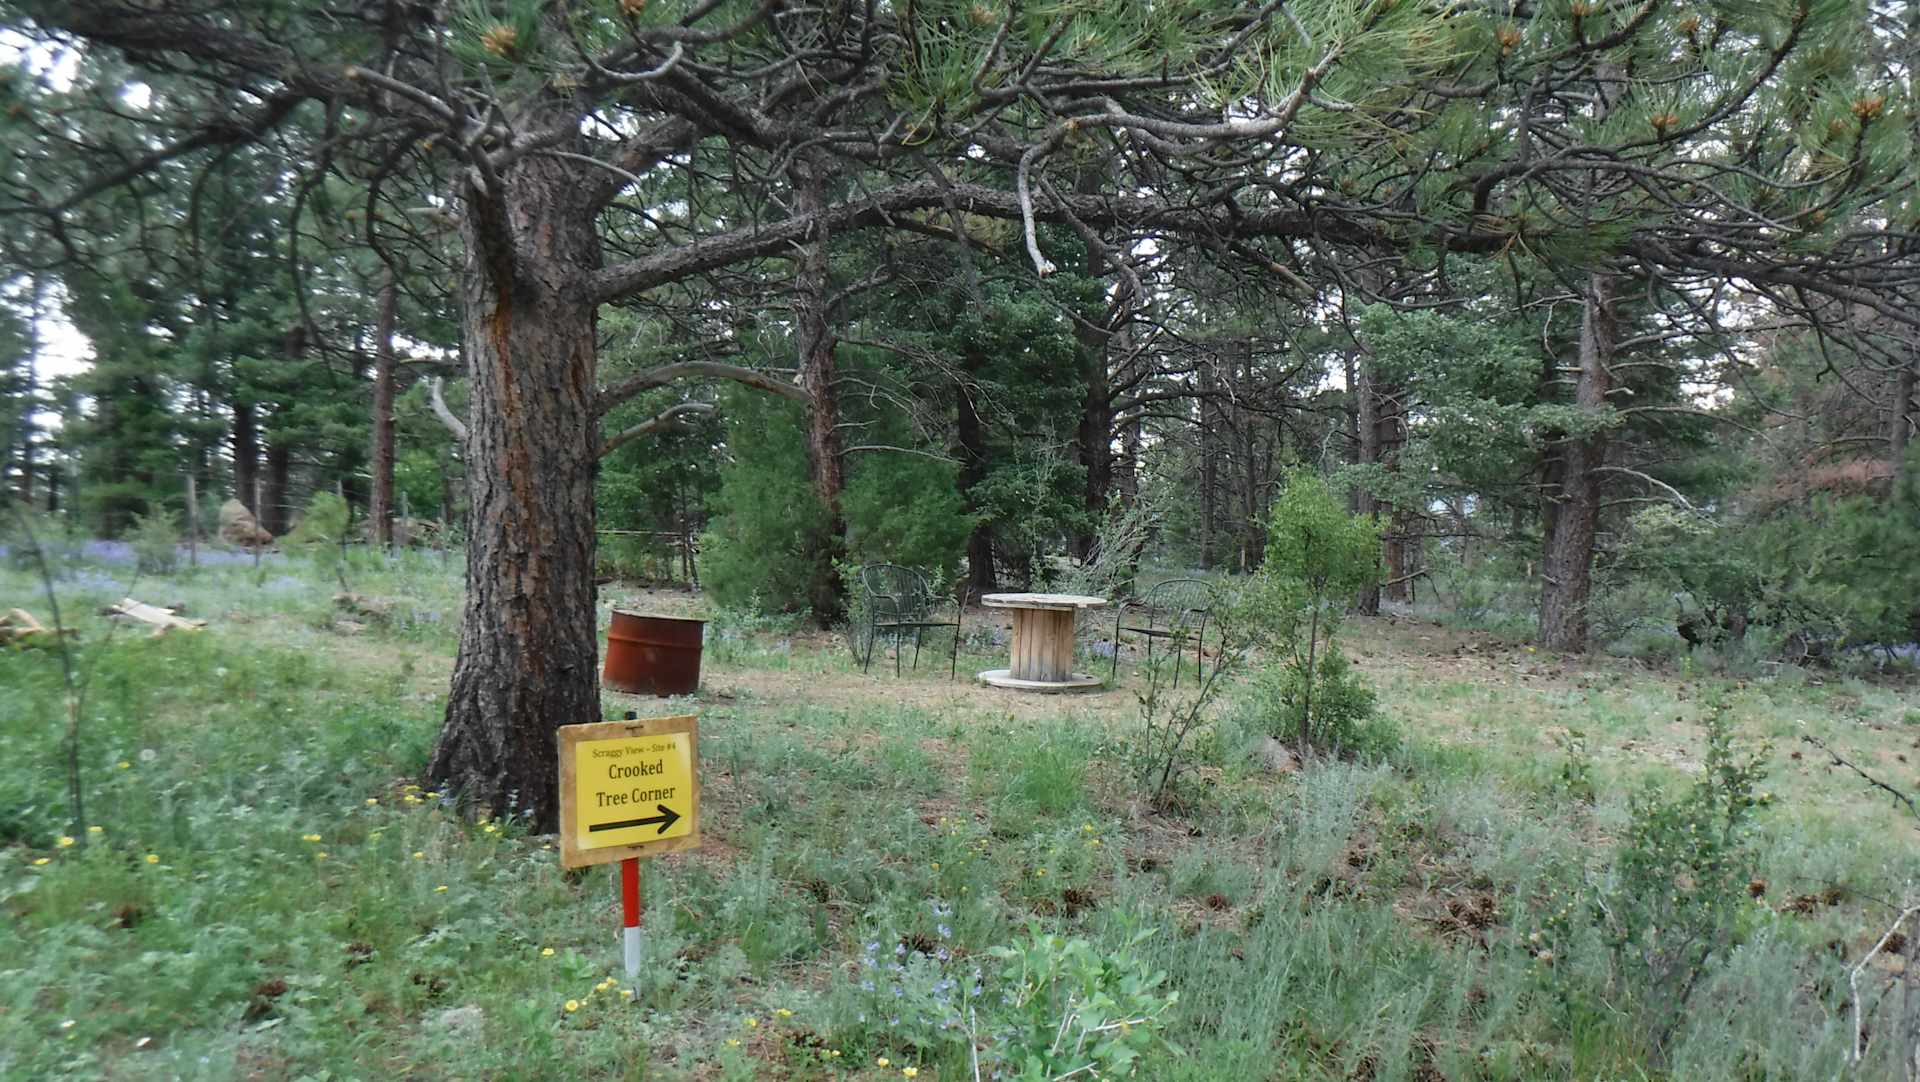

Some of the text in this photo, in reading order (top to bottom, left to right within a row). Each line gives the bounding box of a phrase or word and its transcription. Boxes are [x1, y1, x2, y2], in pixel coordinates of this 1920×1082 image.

[625, 745, 644, 755] View
[608, 758, 664, 779] Crooked
[596, 787, 676, 808] Tree Corner
